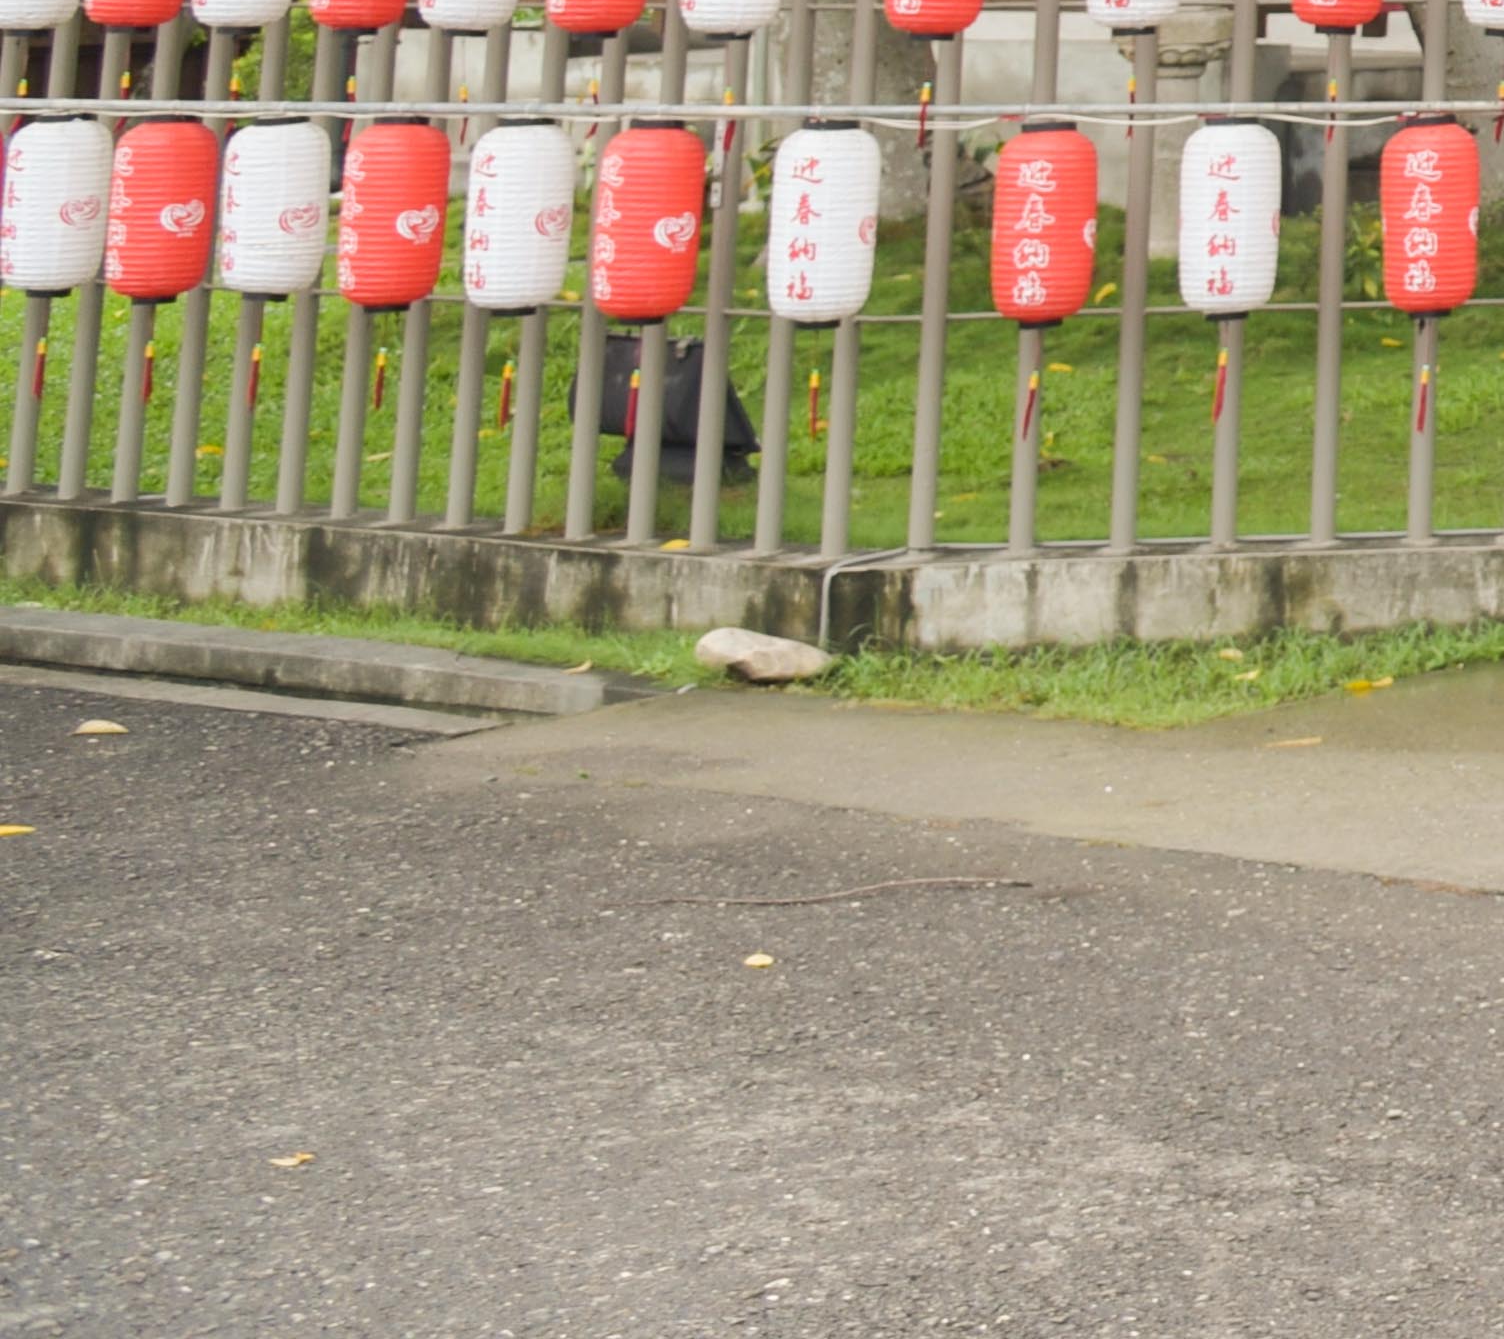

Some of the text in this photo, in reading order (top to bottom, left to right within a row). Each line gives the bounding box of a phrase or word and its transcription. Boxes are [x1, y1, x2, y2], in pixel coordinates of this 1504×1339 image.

[788, 158, 823, 301] 迎春納福
[1012, 161, 1056, 306] 迎春納福
[1207, 155, 1241, 296] 迎春納福
[1403, 150, 1442, 293] 迎春納福
